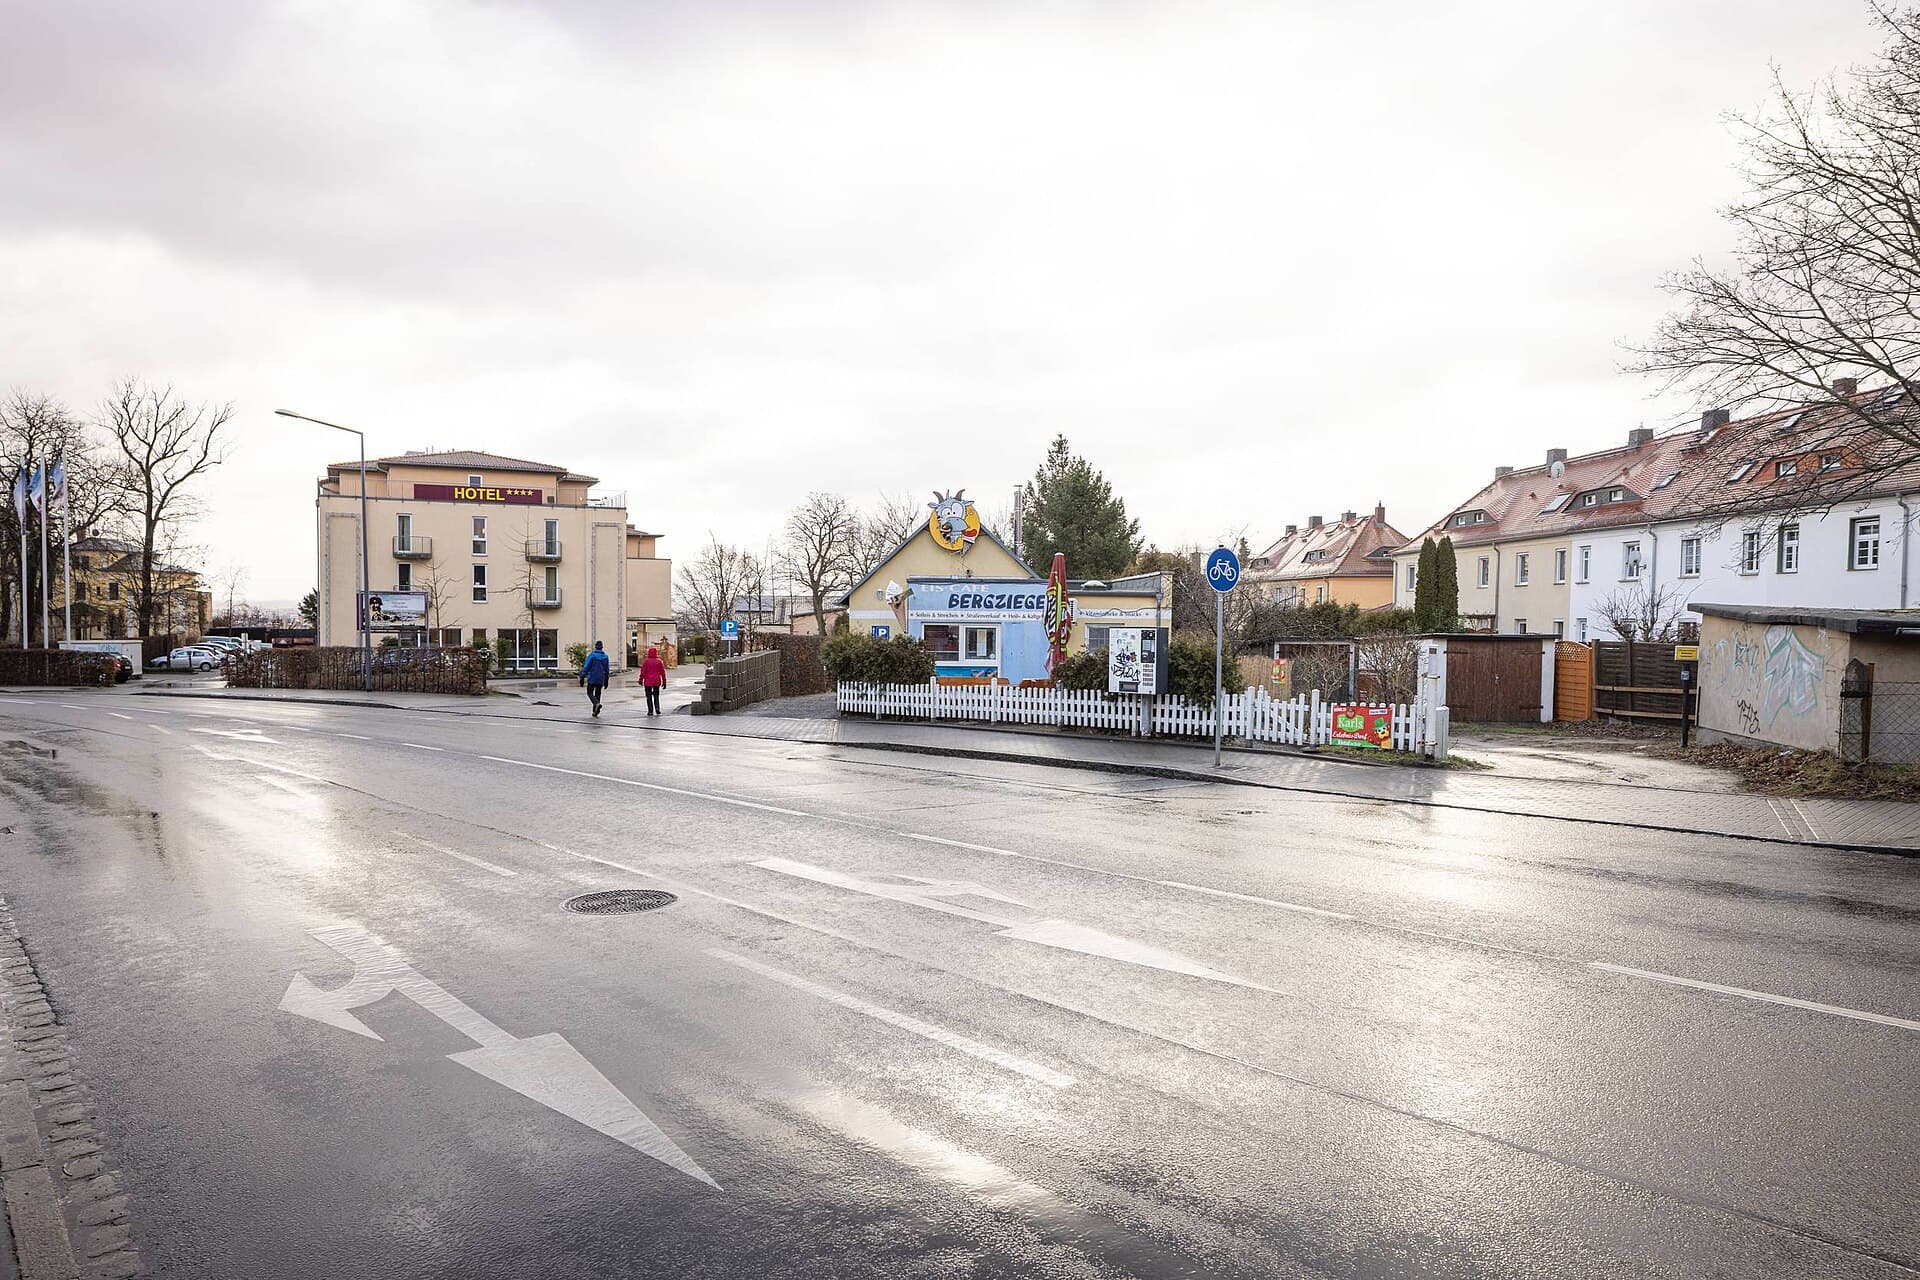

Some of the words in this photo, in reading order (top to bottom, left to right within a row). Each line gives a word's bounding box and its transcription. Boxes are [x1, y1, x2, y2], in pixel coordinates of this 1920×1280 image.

[454, 487, 505, 501] HOTEL
[948, 593, 1045, 609] BERGZIEGE
[726, 621, 734, 632] P
[878, 628, 887, 637] P
[1338, 717, 1364, 728] Karls
